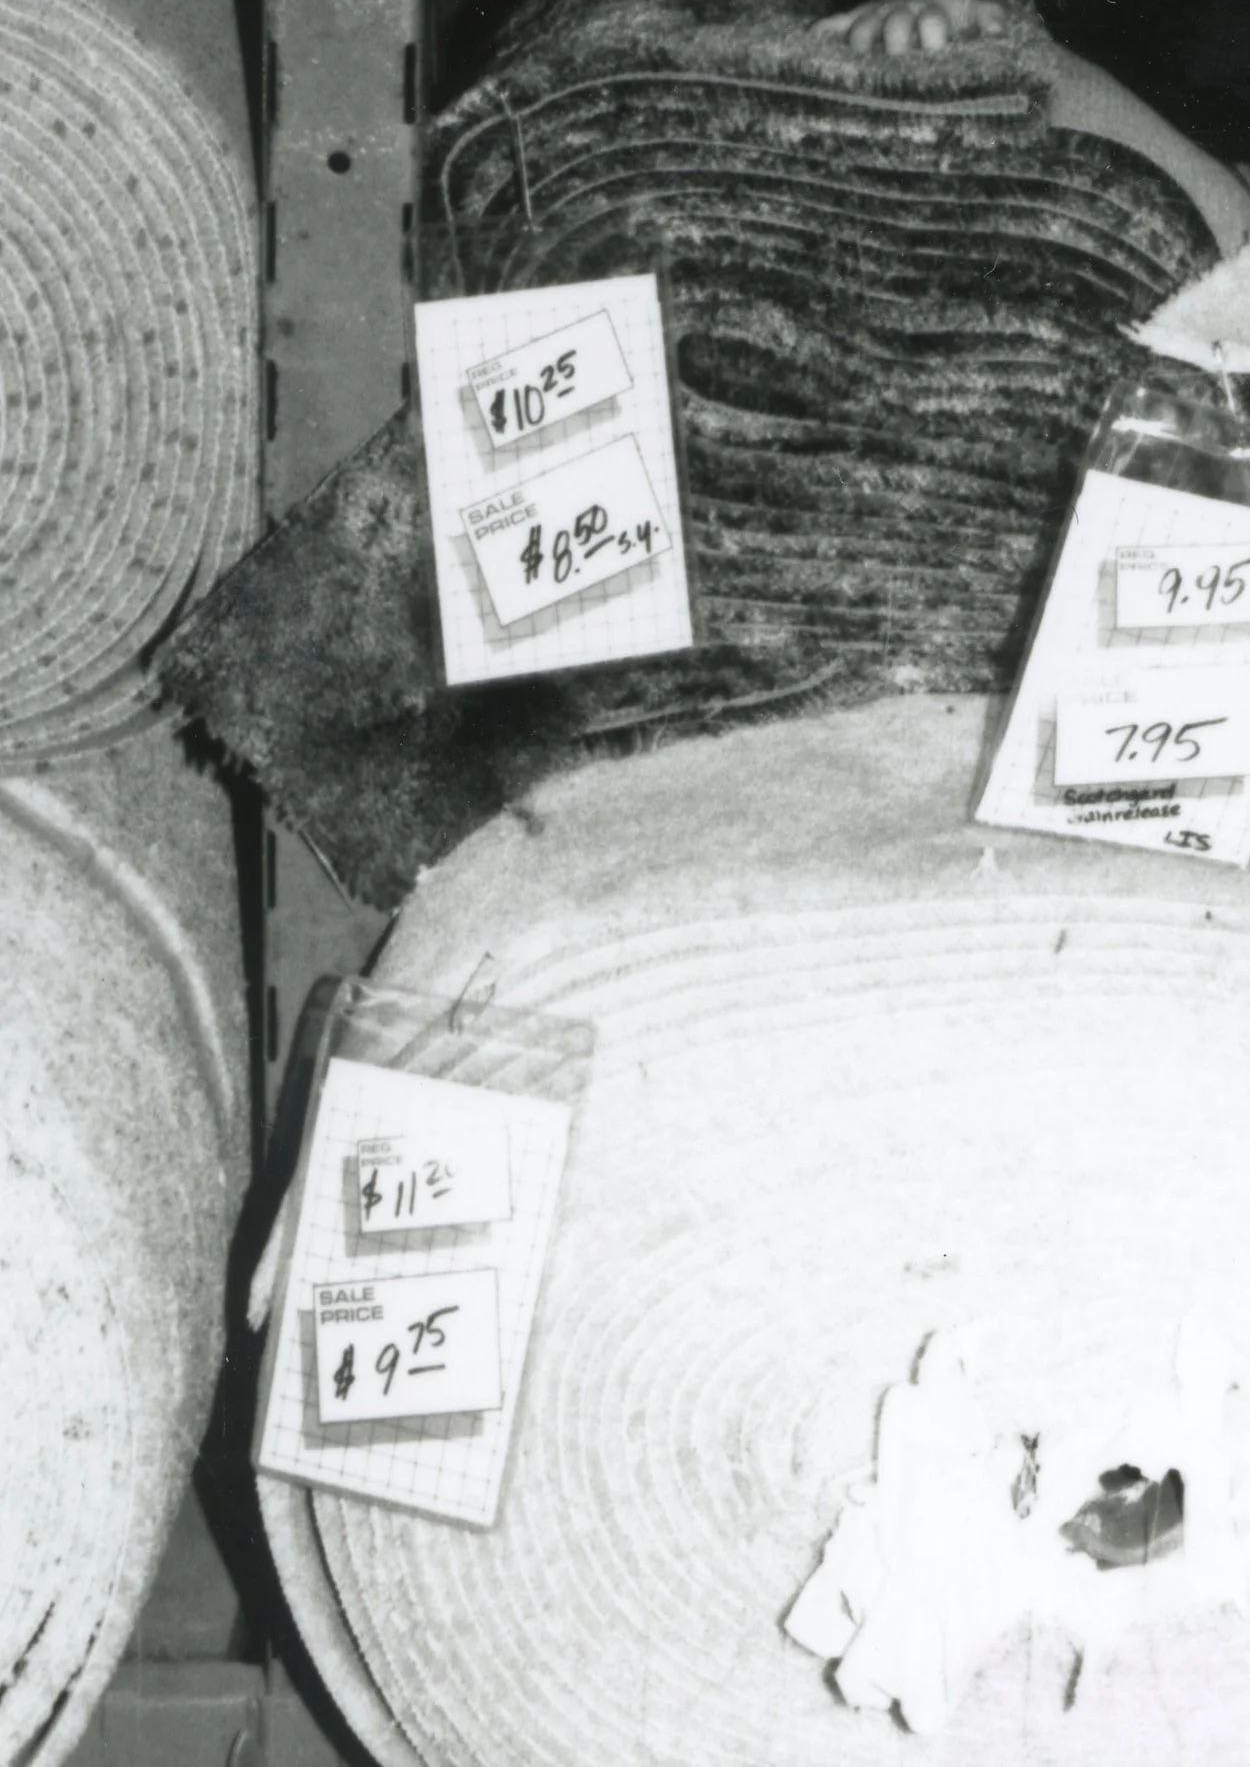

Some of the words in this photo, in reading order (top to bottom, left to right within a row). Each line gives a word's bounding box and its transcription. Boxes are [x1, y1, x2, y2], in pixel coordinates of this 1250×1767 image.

[468, 491, 525, 524] SALE
[475, 503, 538, 540] PRICE
[1105, 717, 1228, 763] 7.95
[319, 1286, 375, 1306] SALE
[320, 1305, 384, 1325] PRICE
